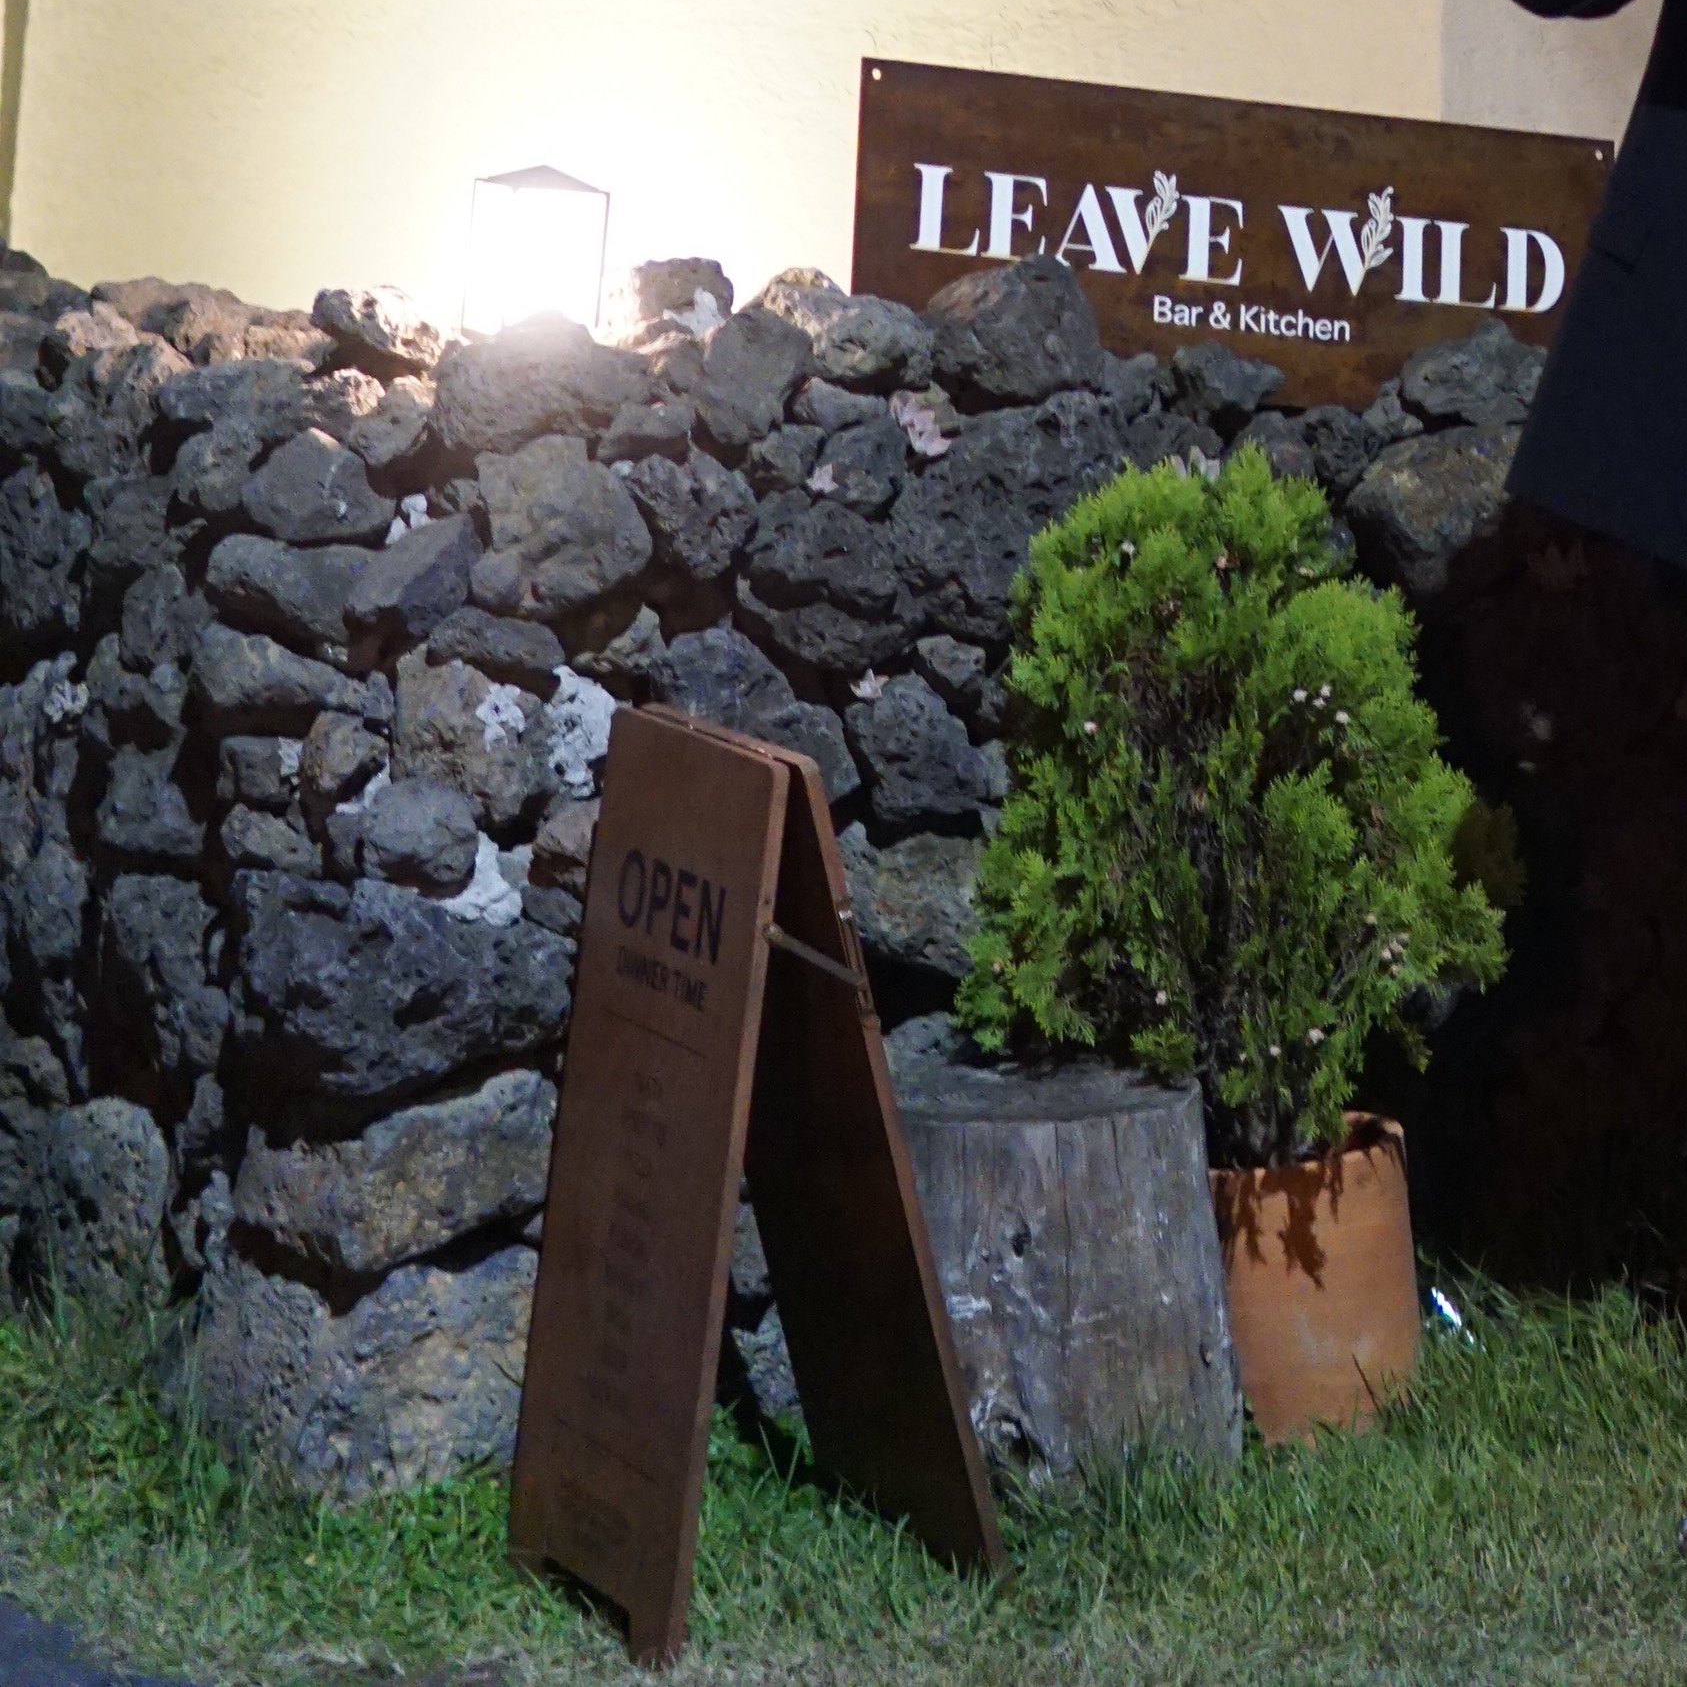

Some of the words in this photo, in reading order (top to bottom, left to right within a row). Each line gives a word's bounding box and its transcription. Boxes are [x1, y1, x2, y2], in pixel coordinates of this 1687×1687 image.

[909, 163, 1244, 287] LEAVE
[1277, 185, 1567, 313] WILD
[1151, 294, 1204, 329] Bar
[1208, 300, 1233, 331] &
[1238, 302, 1352, 343] Kitchen
[618, 848, 728, 966] OPEN
[672, 969, 707, 1012] TIME
